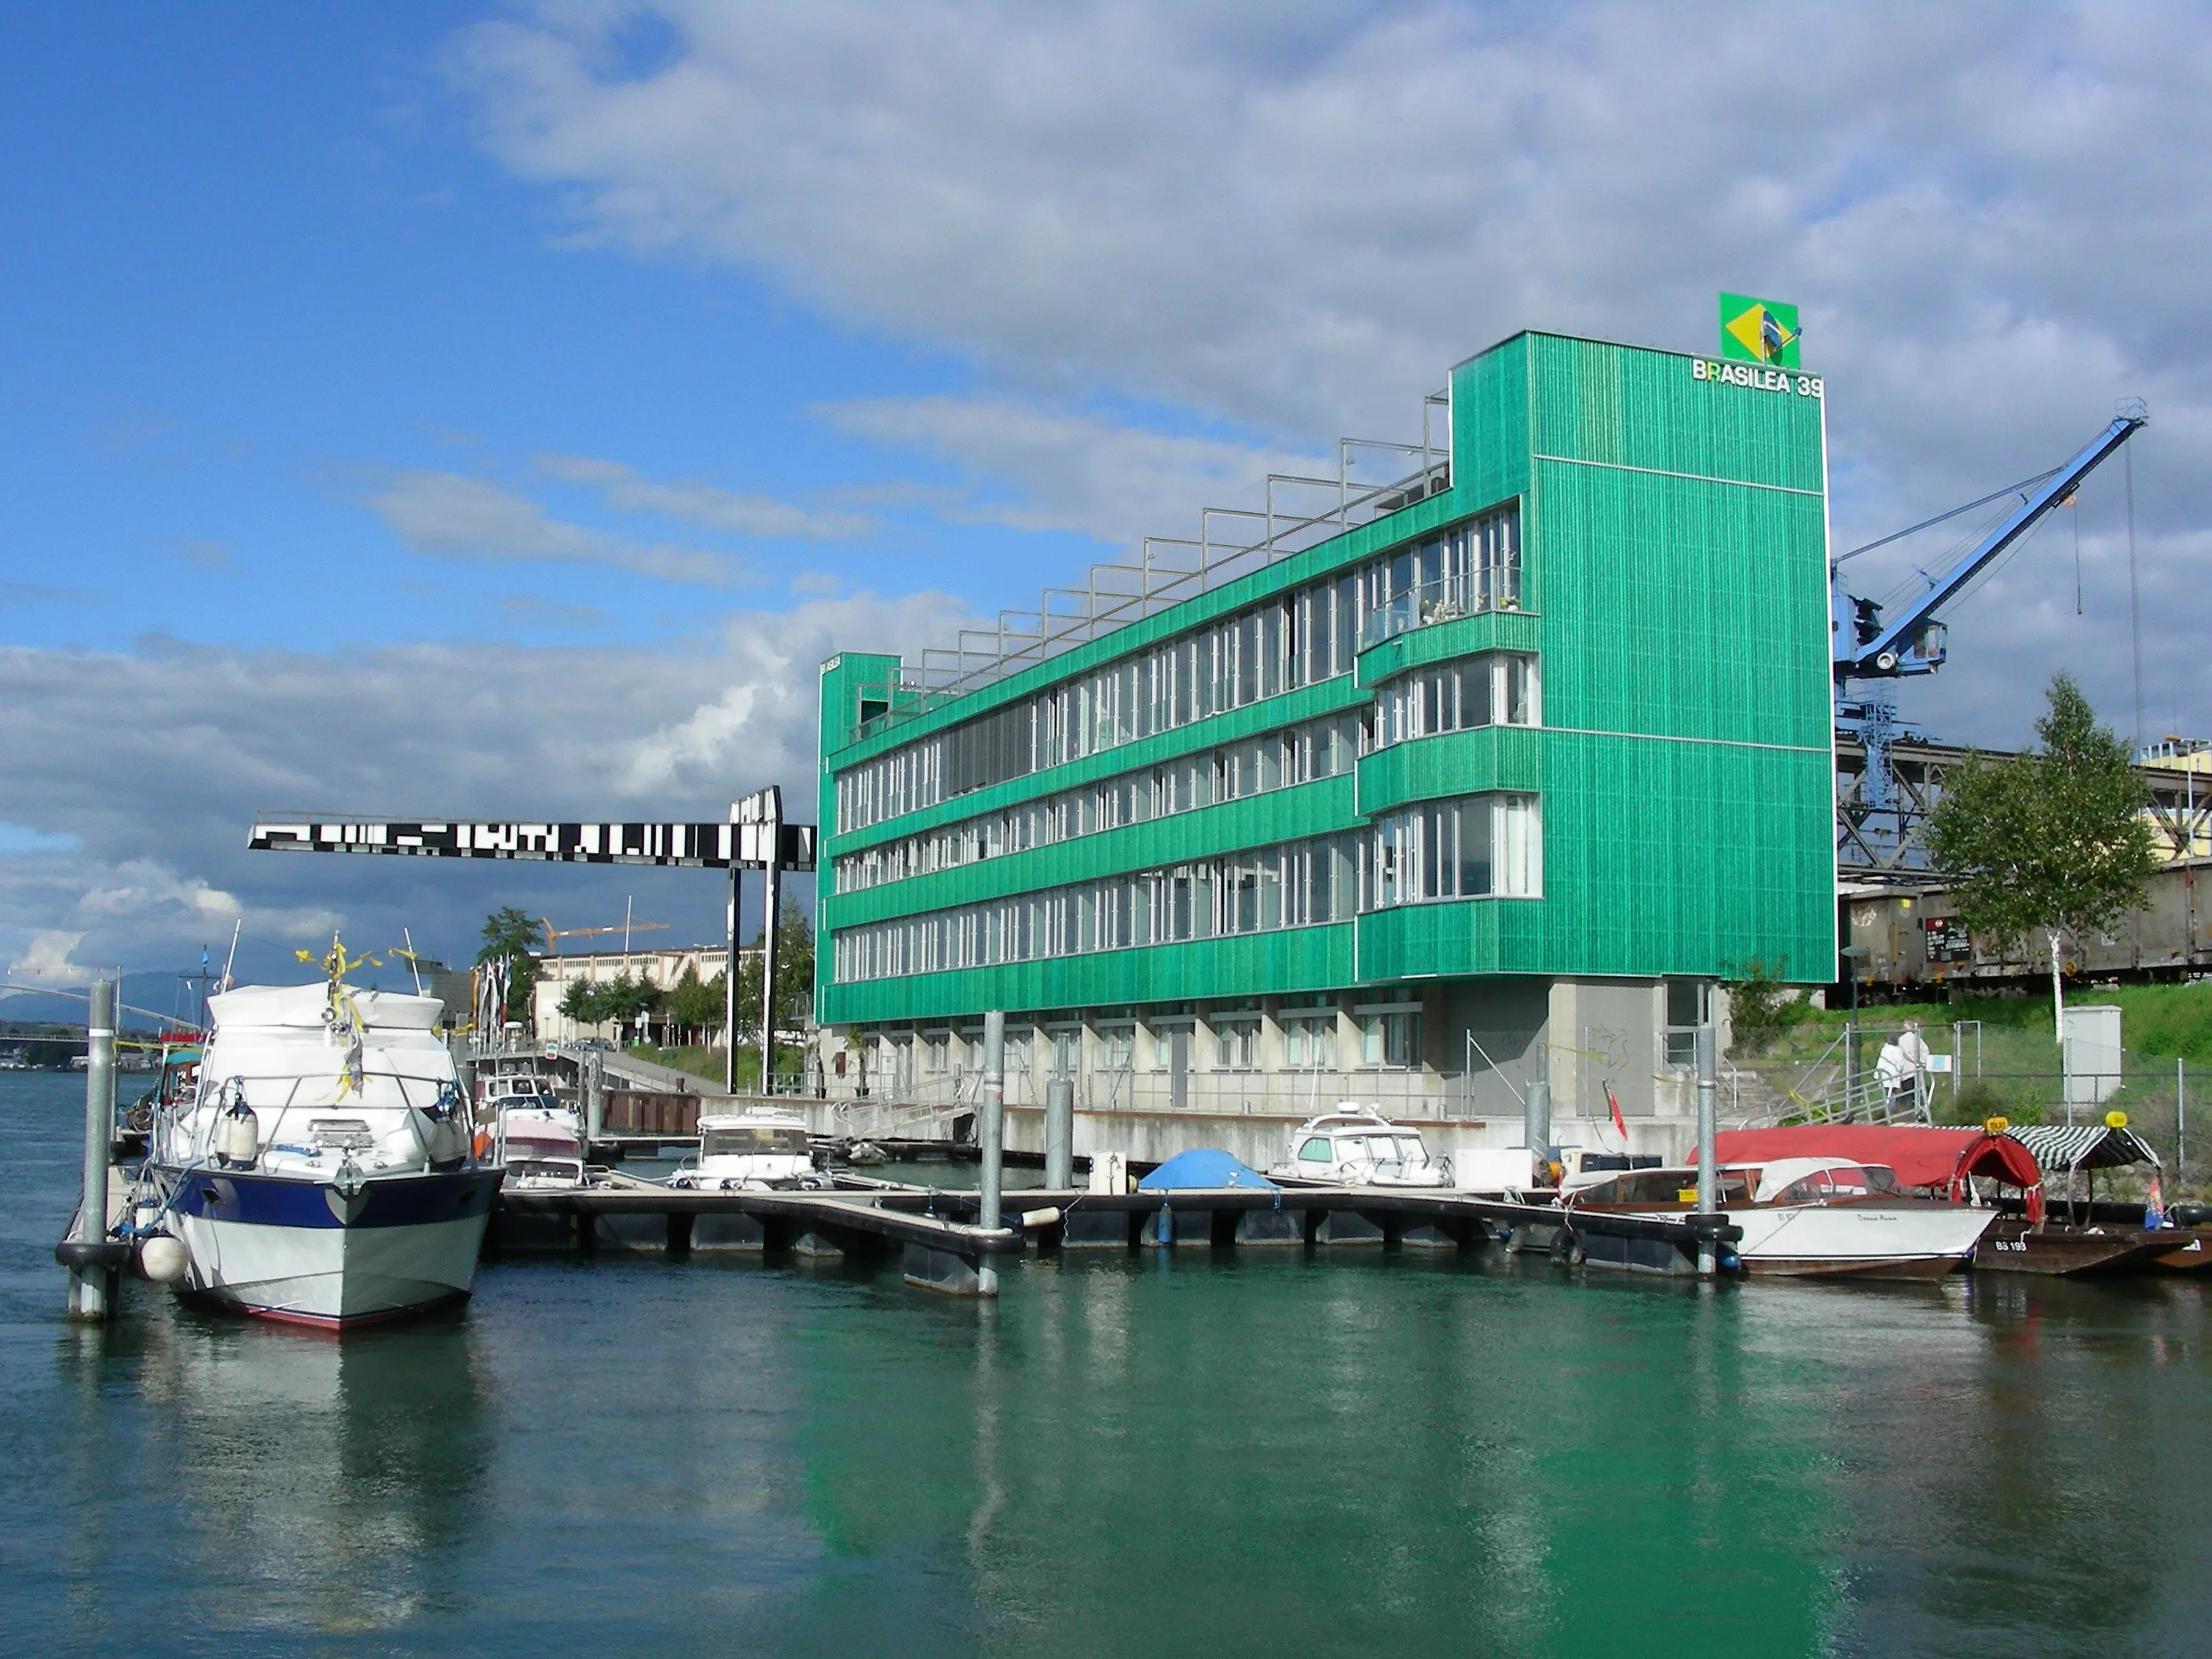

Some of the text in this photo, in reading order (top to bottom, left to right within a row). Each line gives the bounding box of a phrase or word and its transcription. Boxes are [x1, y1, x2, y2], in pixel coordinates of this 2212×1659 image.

[1692, 359, 1822, 398] BRASILEA 39
[1995, 1241, 2027, 1251] BS 193
